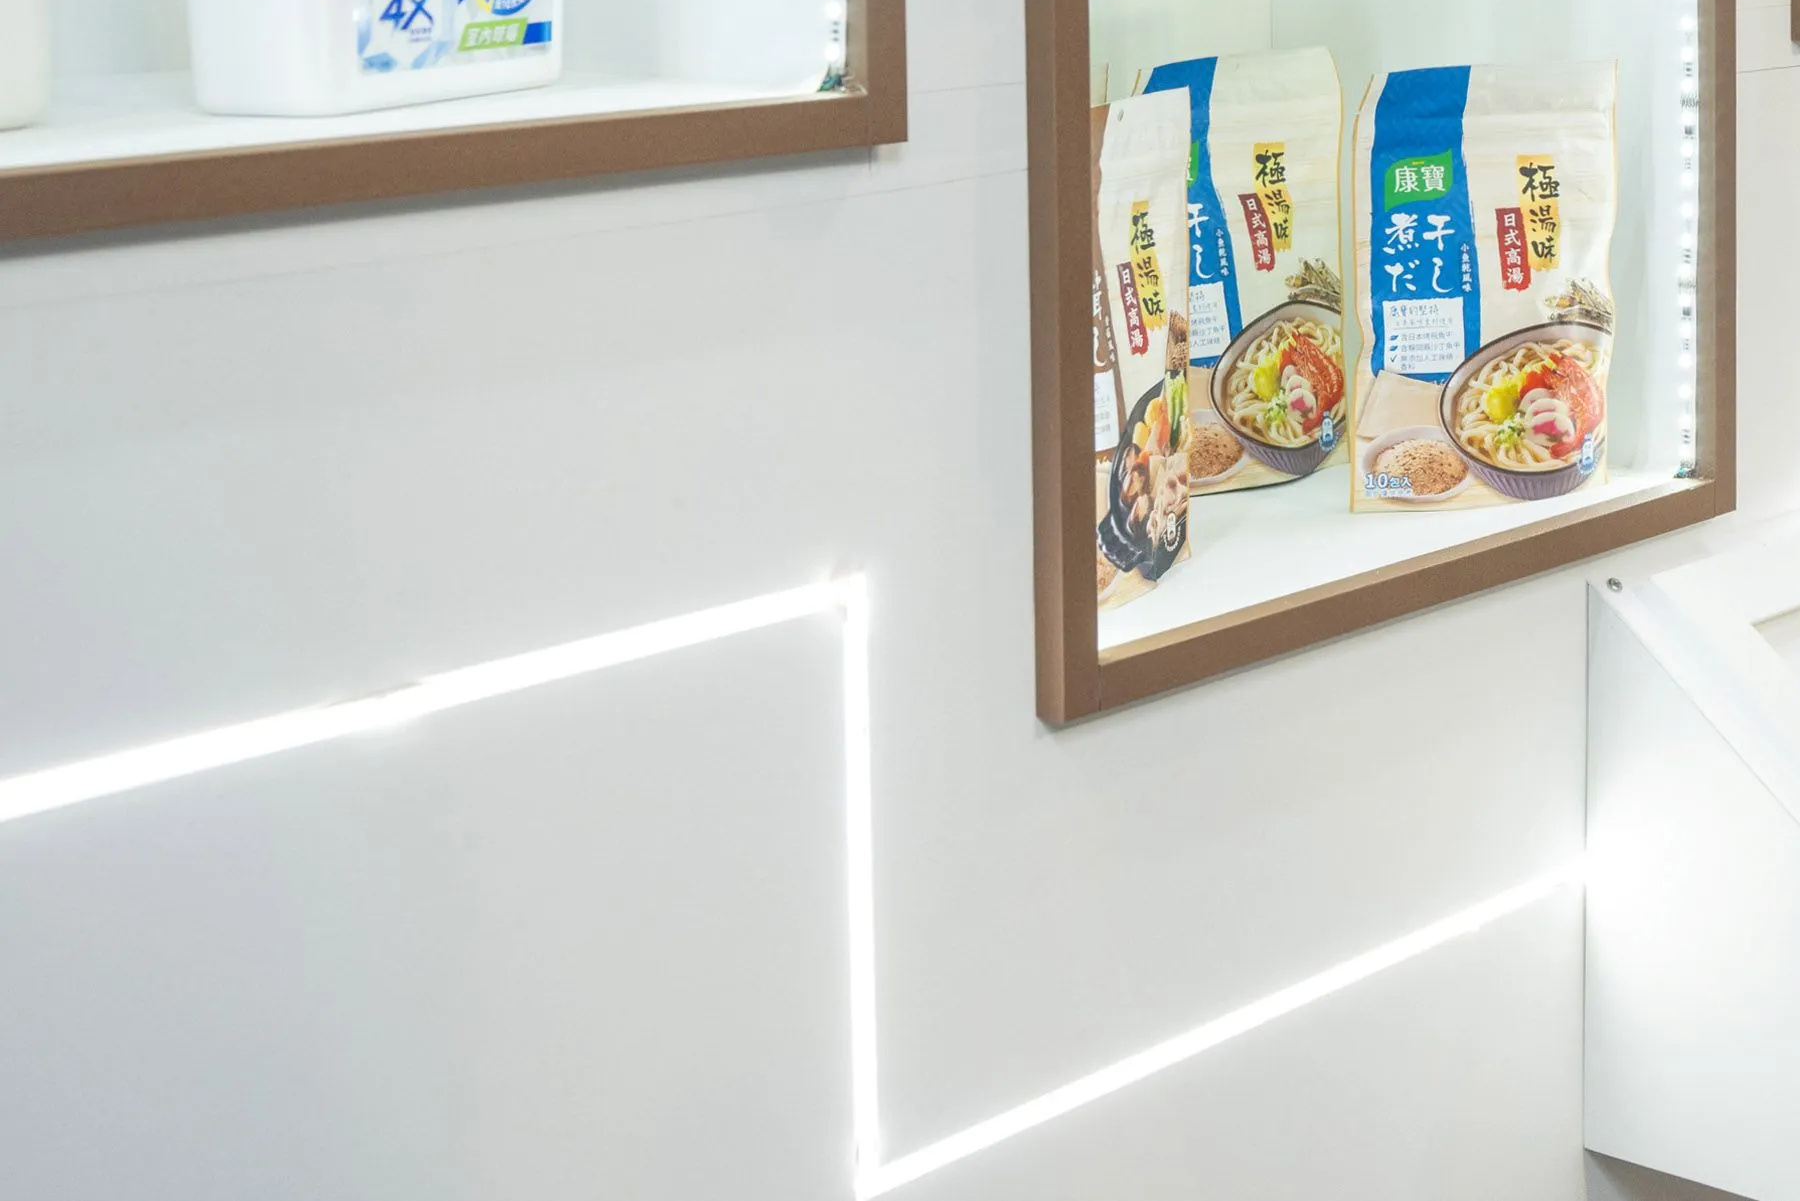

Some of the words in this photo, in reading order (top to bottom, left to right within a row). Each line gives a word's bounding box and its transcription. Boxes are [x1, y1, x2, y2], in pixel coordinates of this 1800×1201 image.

[1255, 149, 1290, 240] 極湯味
[1394, 165, 1446, 193] 康寶
[1518, 161, 1561, 264] 極湯味
[1131, 210, 1164, 321] 極湯味
[1246, 197, 1272, 265] 日式高湯
[1503, 212, 1525, 285] 日式高湯
[1121, 268, 1145, 349] 日式高湯
[1364, 472, 1413, 490] 10包入
